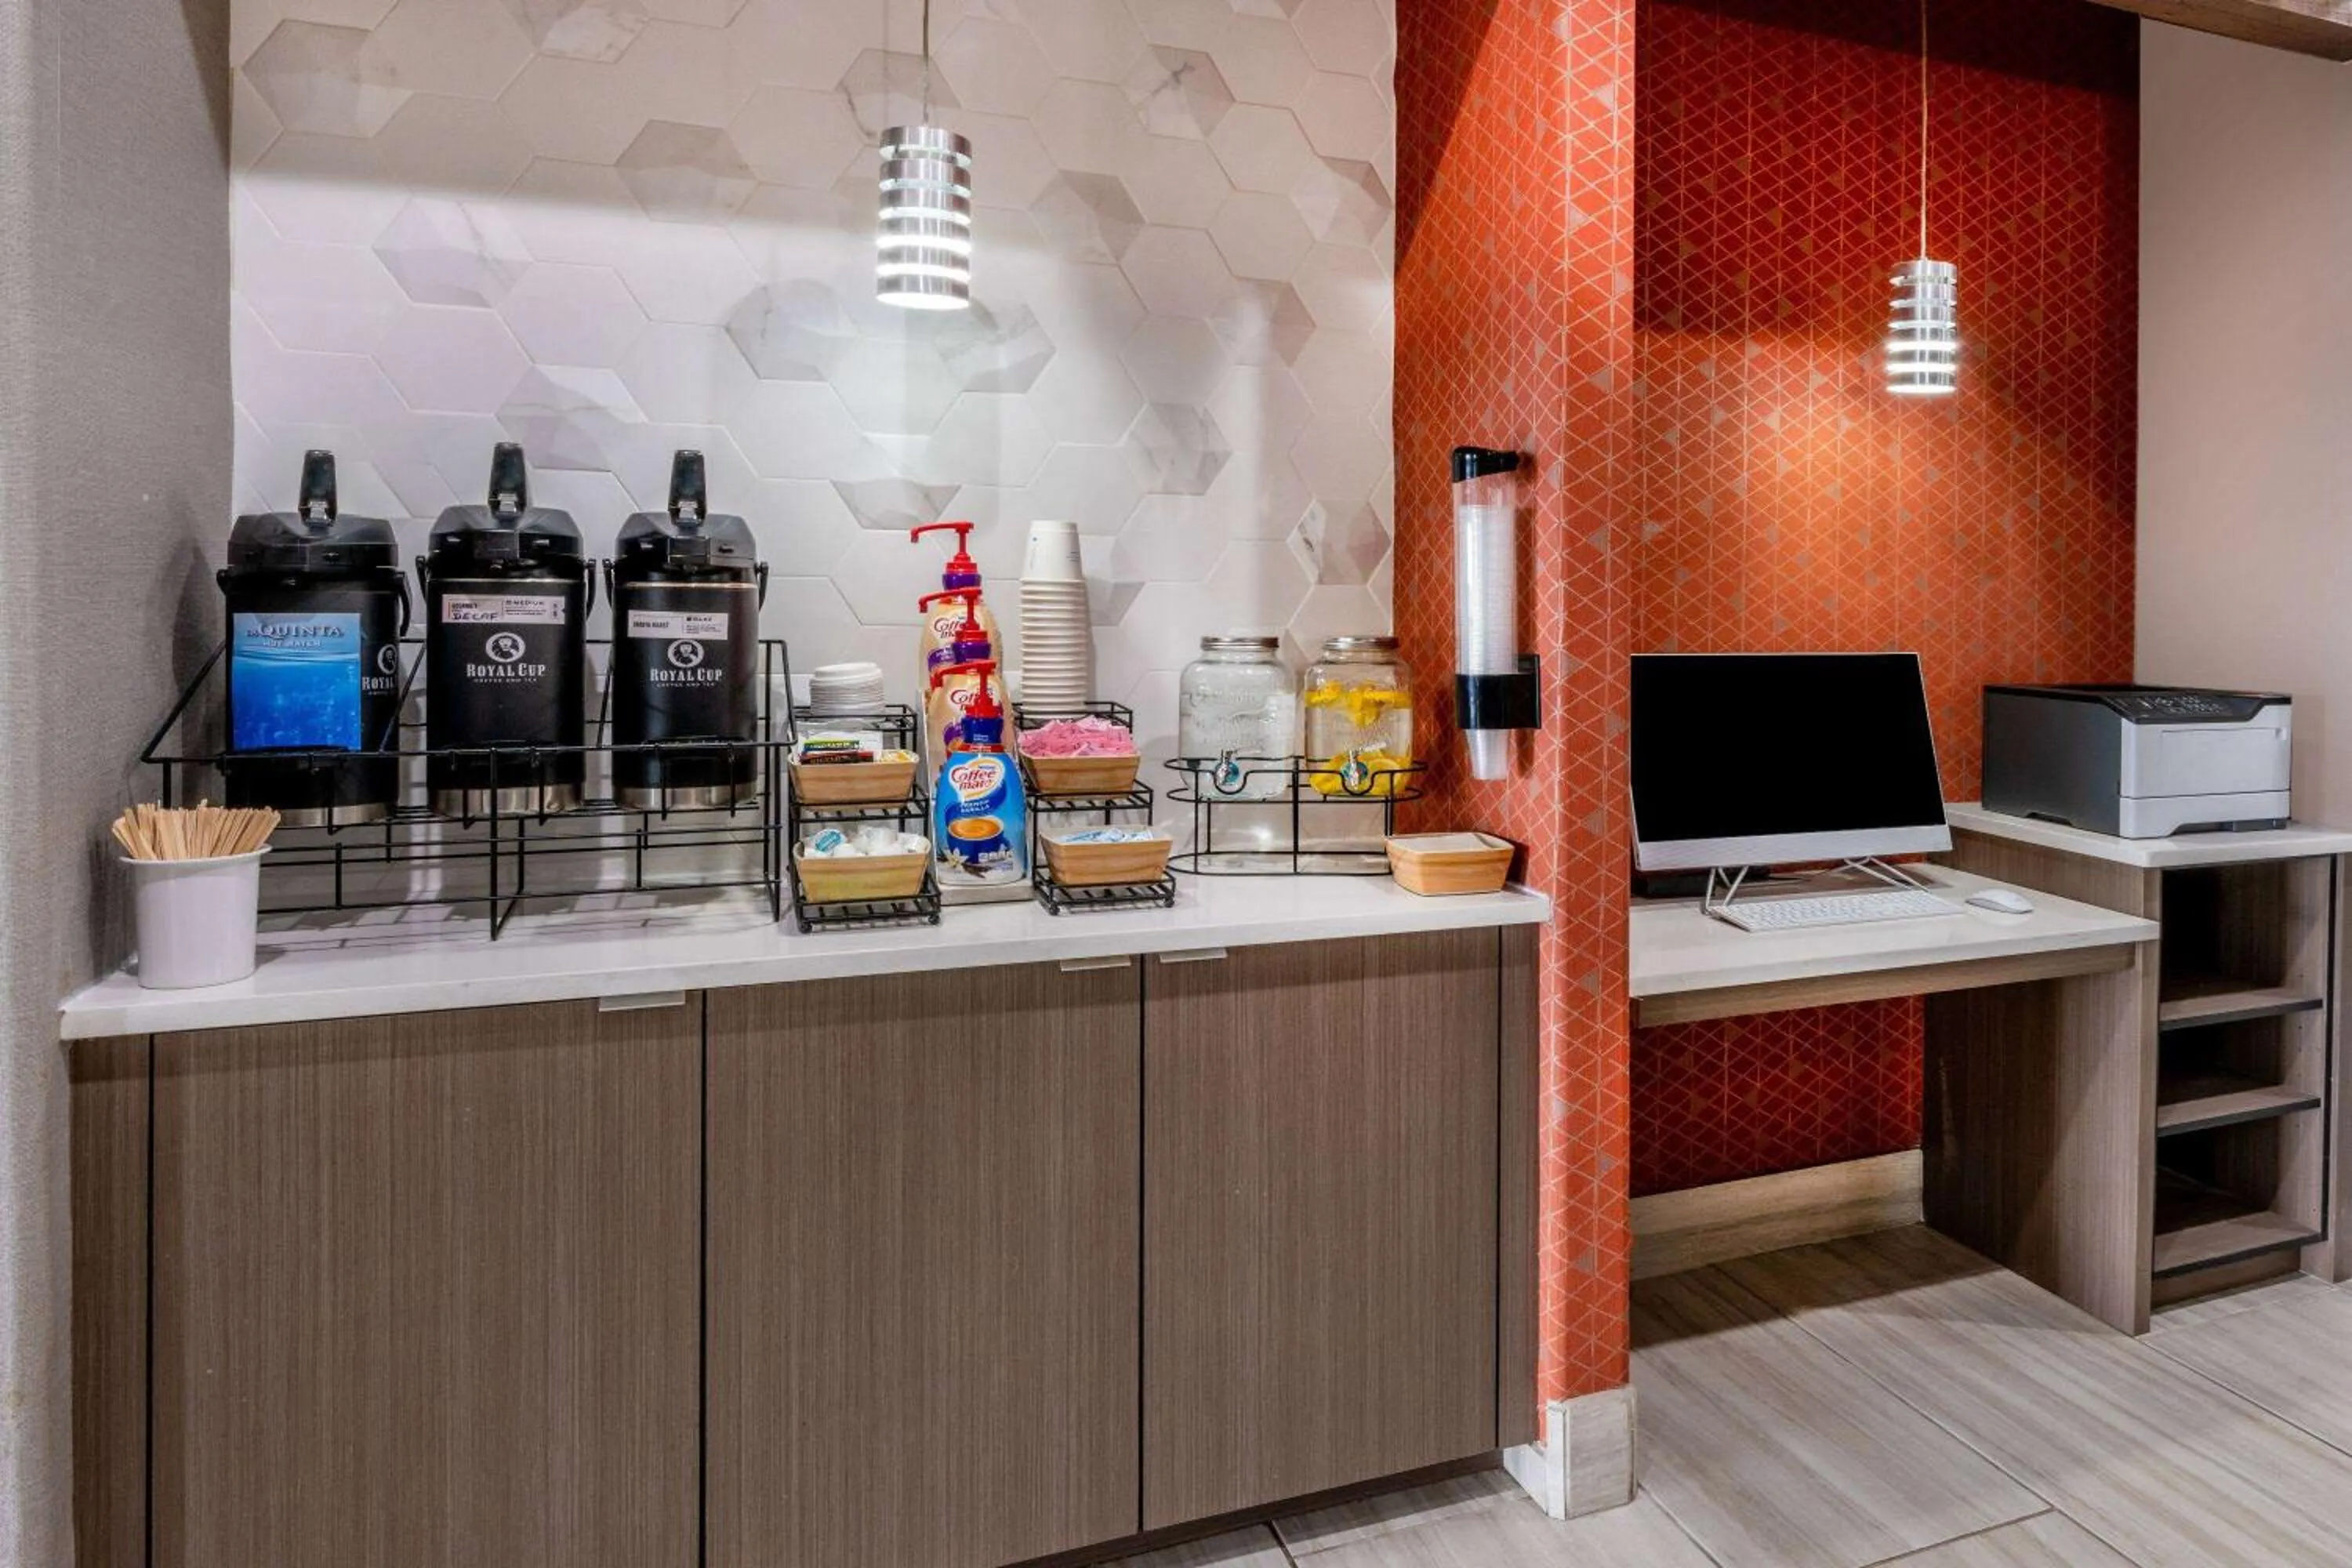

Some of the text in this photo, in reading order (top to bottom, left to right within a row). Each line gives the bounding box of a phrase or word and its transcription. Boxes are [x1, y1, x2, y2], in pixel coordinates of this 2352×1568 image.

[452, 612, 499, 621] DECAF
[258, 624, 345, 641] QUINTA
[466, 662, 546, 677] ROYAL CUP
[649, 668, 723, 681] ROYAL CUP
[951, 766, 996, 783] Coffee
